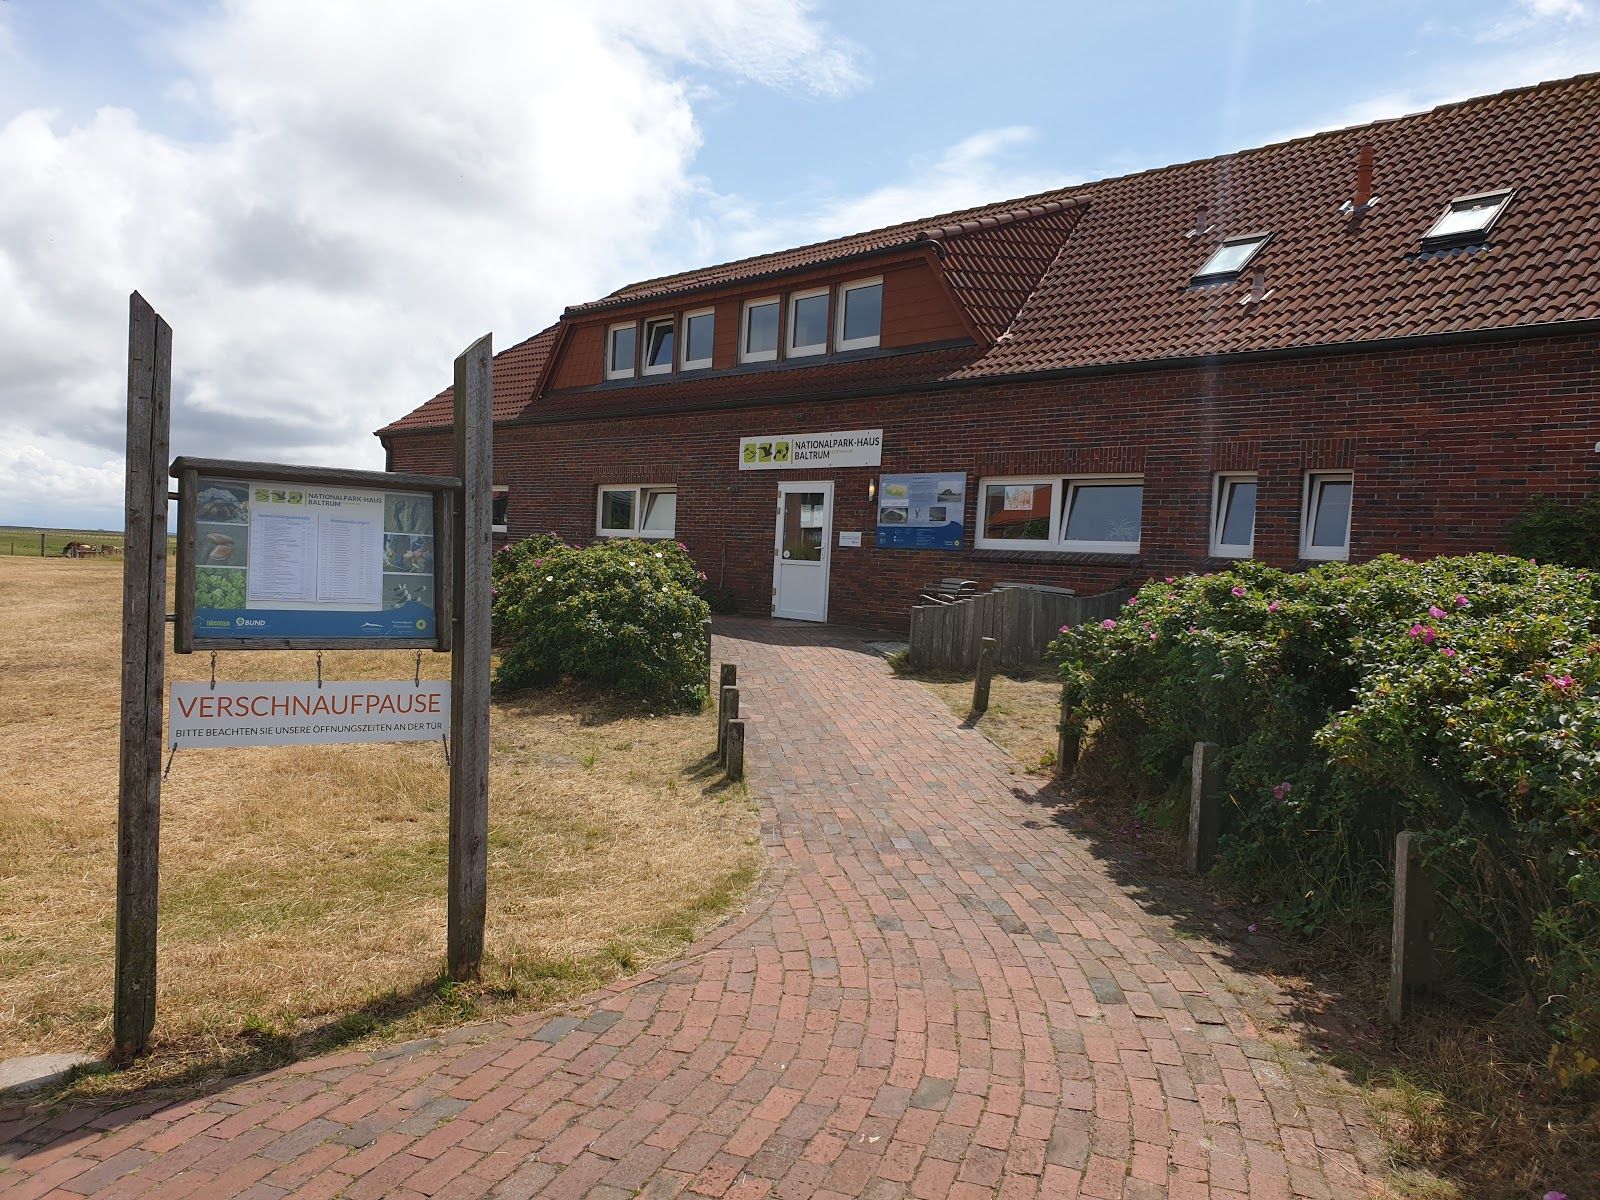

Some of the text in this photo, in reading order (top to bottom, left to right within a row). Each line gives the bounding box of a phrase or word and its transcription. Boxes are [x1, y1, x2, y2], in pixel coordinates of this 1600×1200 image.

[795, 437, 880, 450] NATIONALPARK-HAUS
[794, 450, 830, 461] BALTRUM
[308, 493, 382, 504] NATIONALPARK-HAUS
[177, 693, 441, 718] VERSCHNAUFPAUSE
[175, 722, 443, 738] BITTE BEACHTEN SIE UNSERE ÖFFNUNGSZEITEN AN DER TÜR
